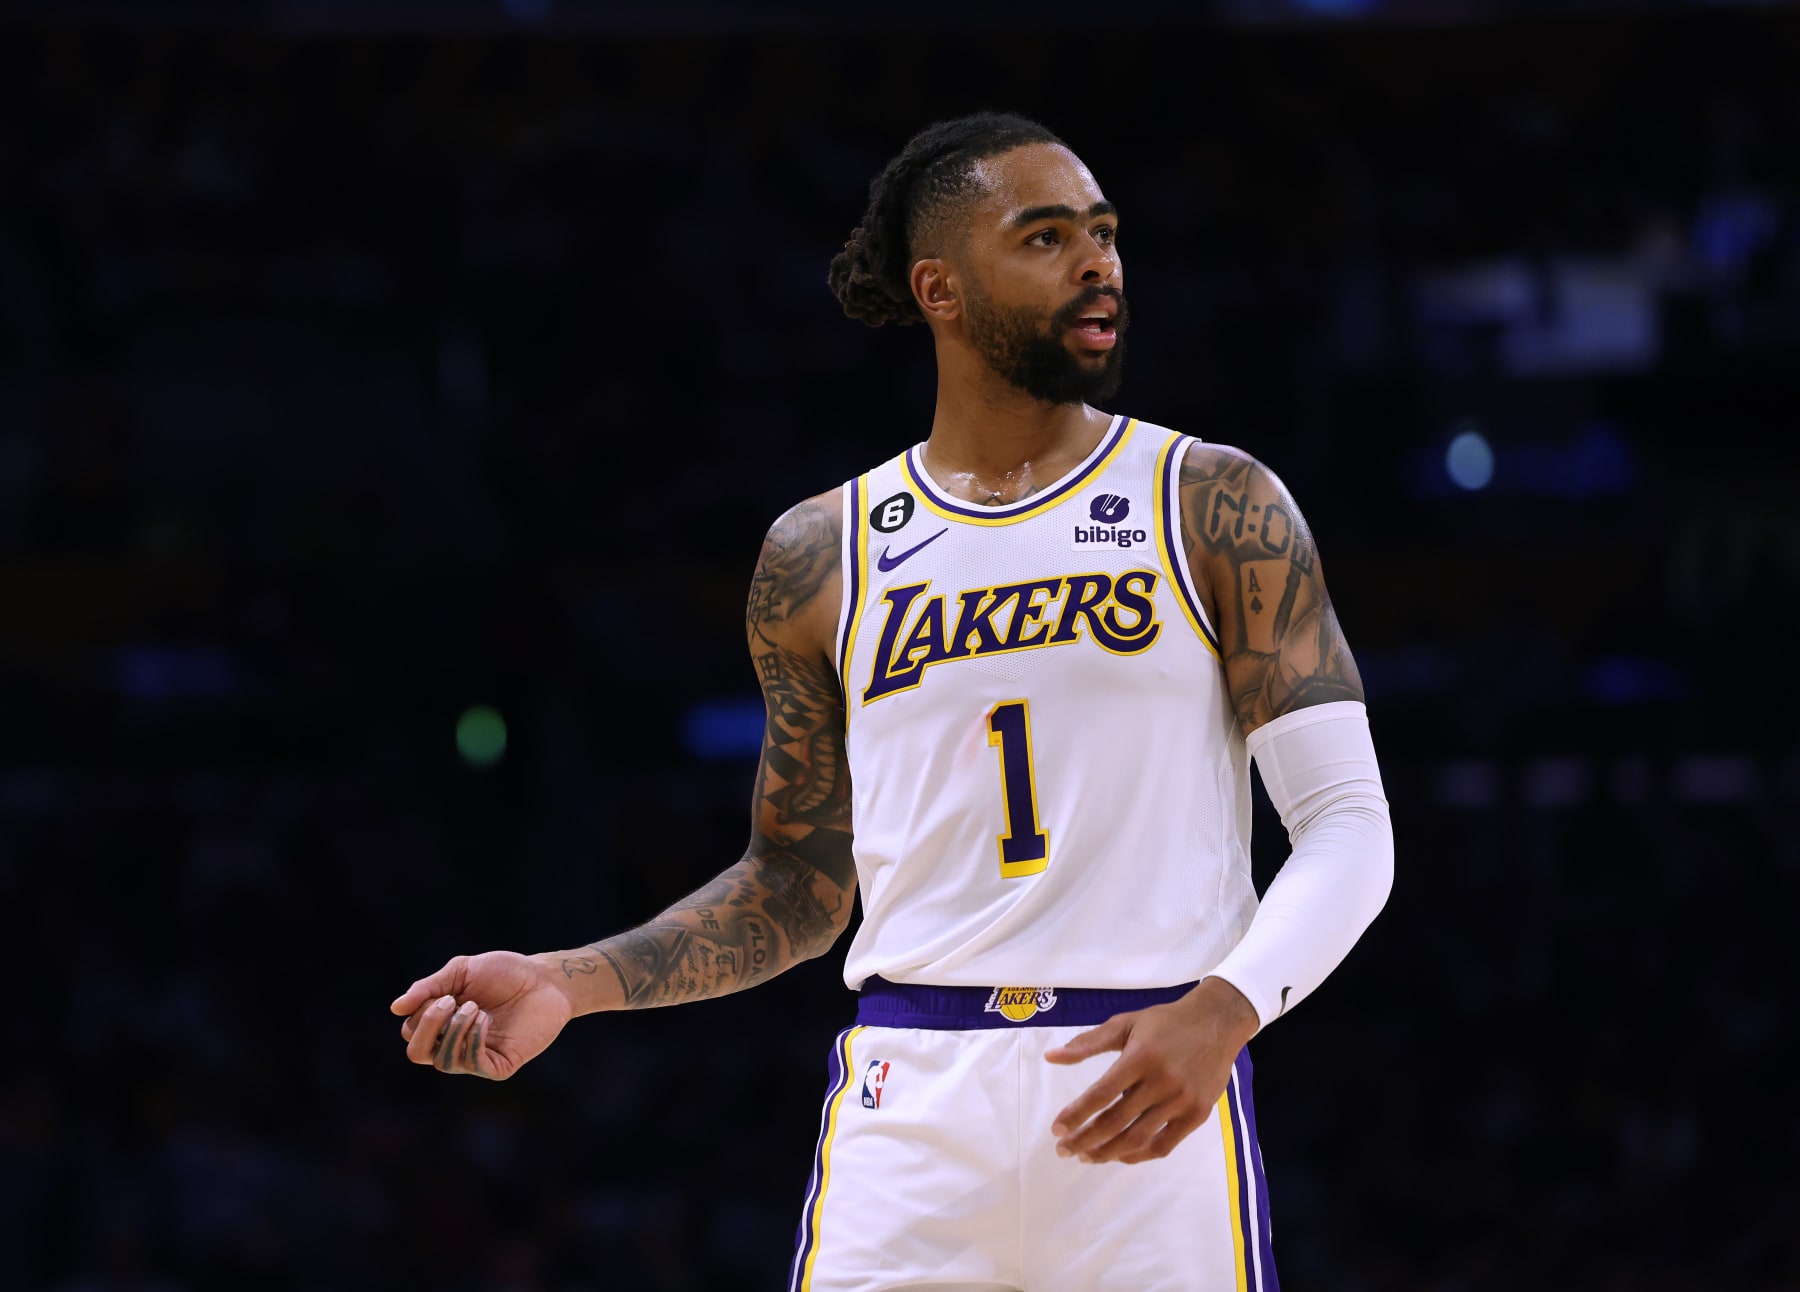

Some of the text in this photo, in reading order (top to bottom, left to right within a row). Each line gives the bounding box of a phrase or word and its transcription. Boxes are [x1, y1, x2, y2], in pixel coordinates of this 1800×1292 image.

[882, 498, 906, 528] 6
[1074, 526, 1147, 548] bibigo
[1248, 567, 1261, 593] A
[862, 569, 1164, 707] LAKERS
[986, 697, 1050, 879] 1
[988, 987, 1056, 1010] LAKERS
